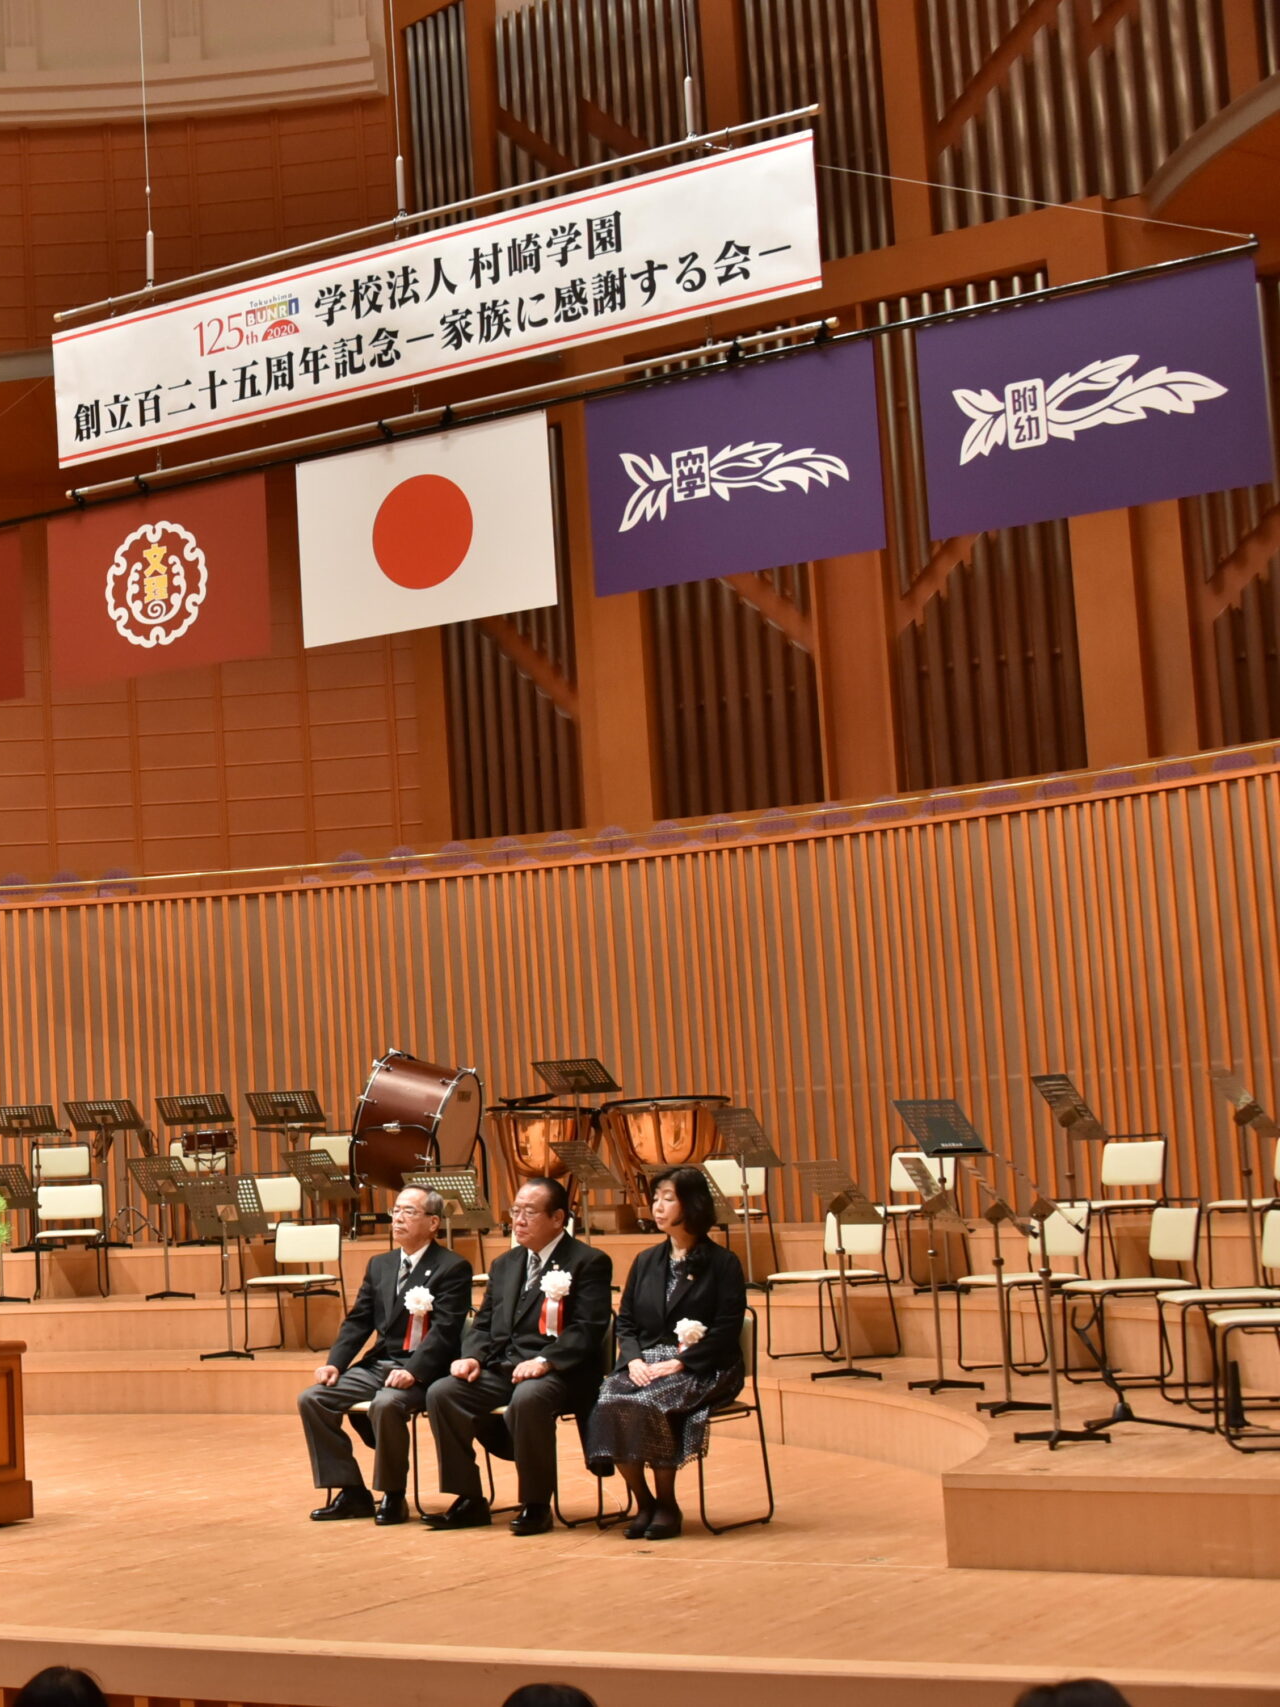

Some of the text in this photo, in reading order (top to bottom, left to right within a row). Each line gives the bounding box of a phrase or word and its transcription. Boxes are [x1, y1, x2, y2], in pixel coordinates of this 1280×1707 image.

[314, 210, 622, 327] 学校法人 村崎学園
[246, 299, 298, 327] BUNRI
[250, 293, 293, 307] Tokushima
[193, 313, 259, 357] 125th
[266, 323, 295, 341] 2020
